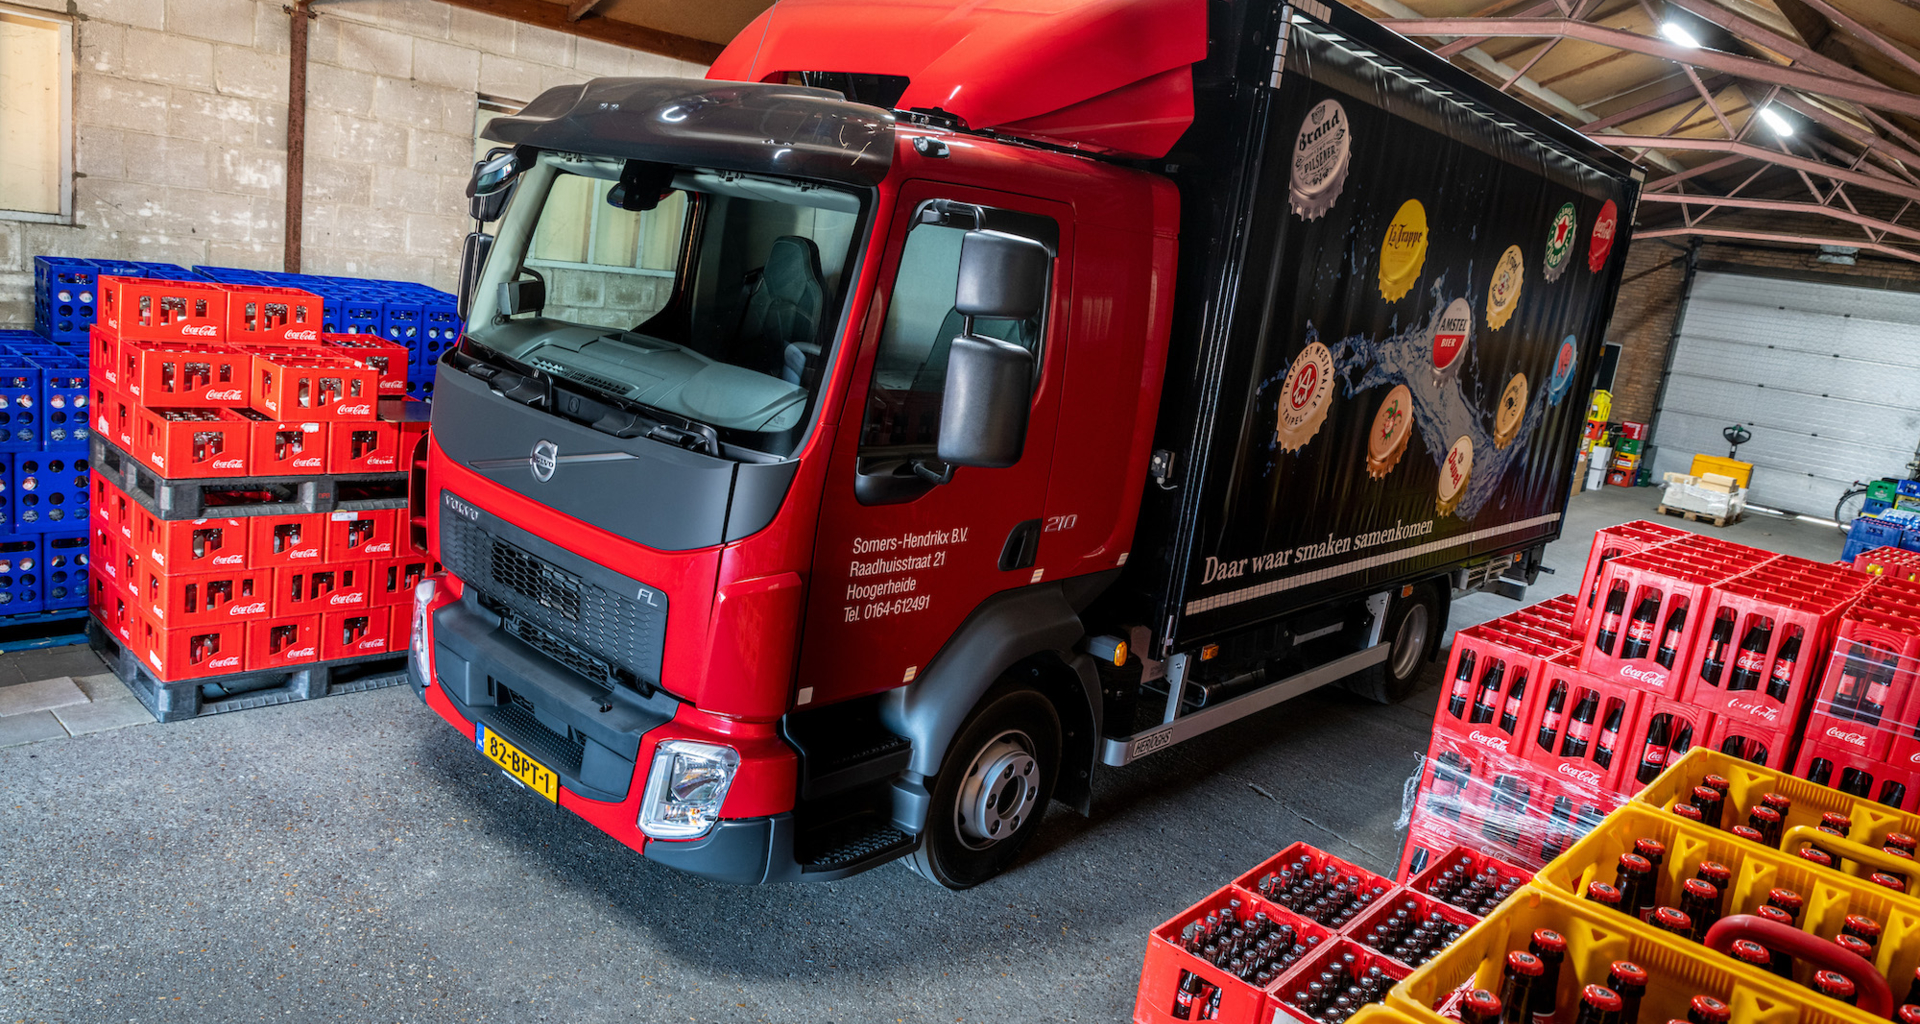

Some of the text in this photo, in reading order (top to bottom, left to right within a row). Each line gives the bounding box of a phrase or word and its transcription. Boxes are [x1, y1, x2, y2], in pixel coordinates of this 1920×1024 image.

[1299, 109, 1340, 151] Brand
[1304, 145, 1336, 173] PILSENER
[1396, 223, 1423, 249] Trappe
[181, 324, 217, 337] Coca-Cola
[1439, 317, 1468, 332] AMSTEL
[284, 329, 317, 341] Coca-Cola
[1441, 338, 1457, 348] BIER
[1283, 345, 1330, 409] TRAPPIST WESTMALLE
[206, 389, 243, 401] Coca-Cola
[337, 404, 371, 415] Coca-Cola
[1282, 408, 1304, 426] TRIPEL
[212, 459, 243, 469] Coca-Cola
[293, 458, 322, 468] Coca-Cola
[1045, 514, 1078, 532] 210
[365, 543, 392, 553] Coca-Cola
[852, 527, 968, 554] Somers-Hendrikx B.V.
[212, 555, 243, 565] Coca-Cola
[290, 549, 319, 559] Coca-Cola
[1201, 518, 1434, 585] Daar waar smaken samenkomen
[849, 551, 946, 577] Raadhuisstraat 21
[636, 587, 658, 608] FL
[846, 577, 917, 601] Hoogerheide
[330, 592, 364, 605] Coca-Cola
[230, 602, 266, 614] Coca-Cola
[843, 595, 931, 622] Tel. 0164-612491
[287, 647, 315, 658] Coca-Cola
[359, 638, 385, 649] Coca-Cola
[209, 656, 240, 668] Coca-Cola
[1620, 664, 1665, 688] Coca-Cola
[1469, 730, 1510, 751] Coca-Cola
[1826, 726, 1868, 747] Coca-Cola
[490, 737, 549, 794] 82-BPT-1
[1558, 763, 1602, 786] Coca-Cola
